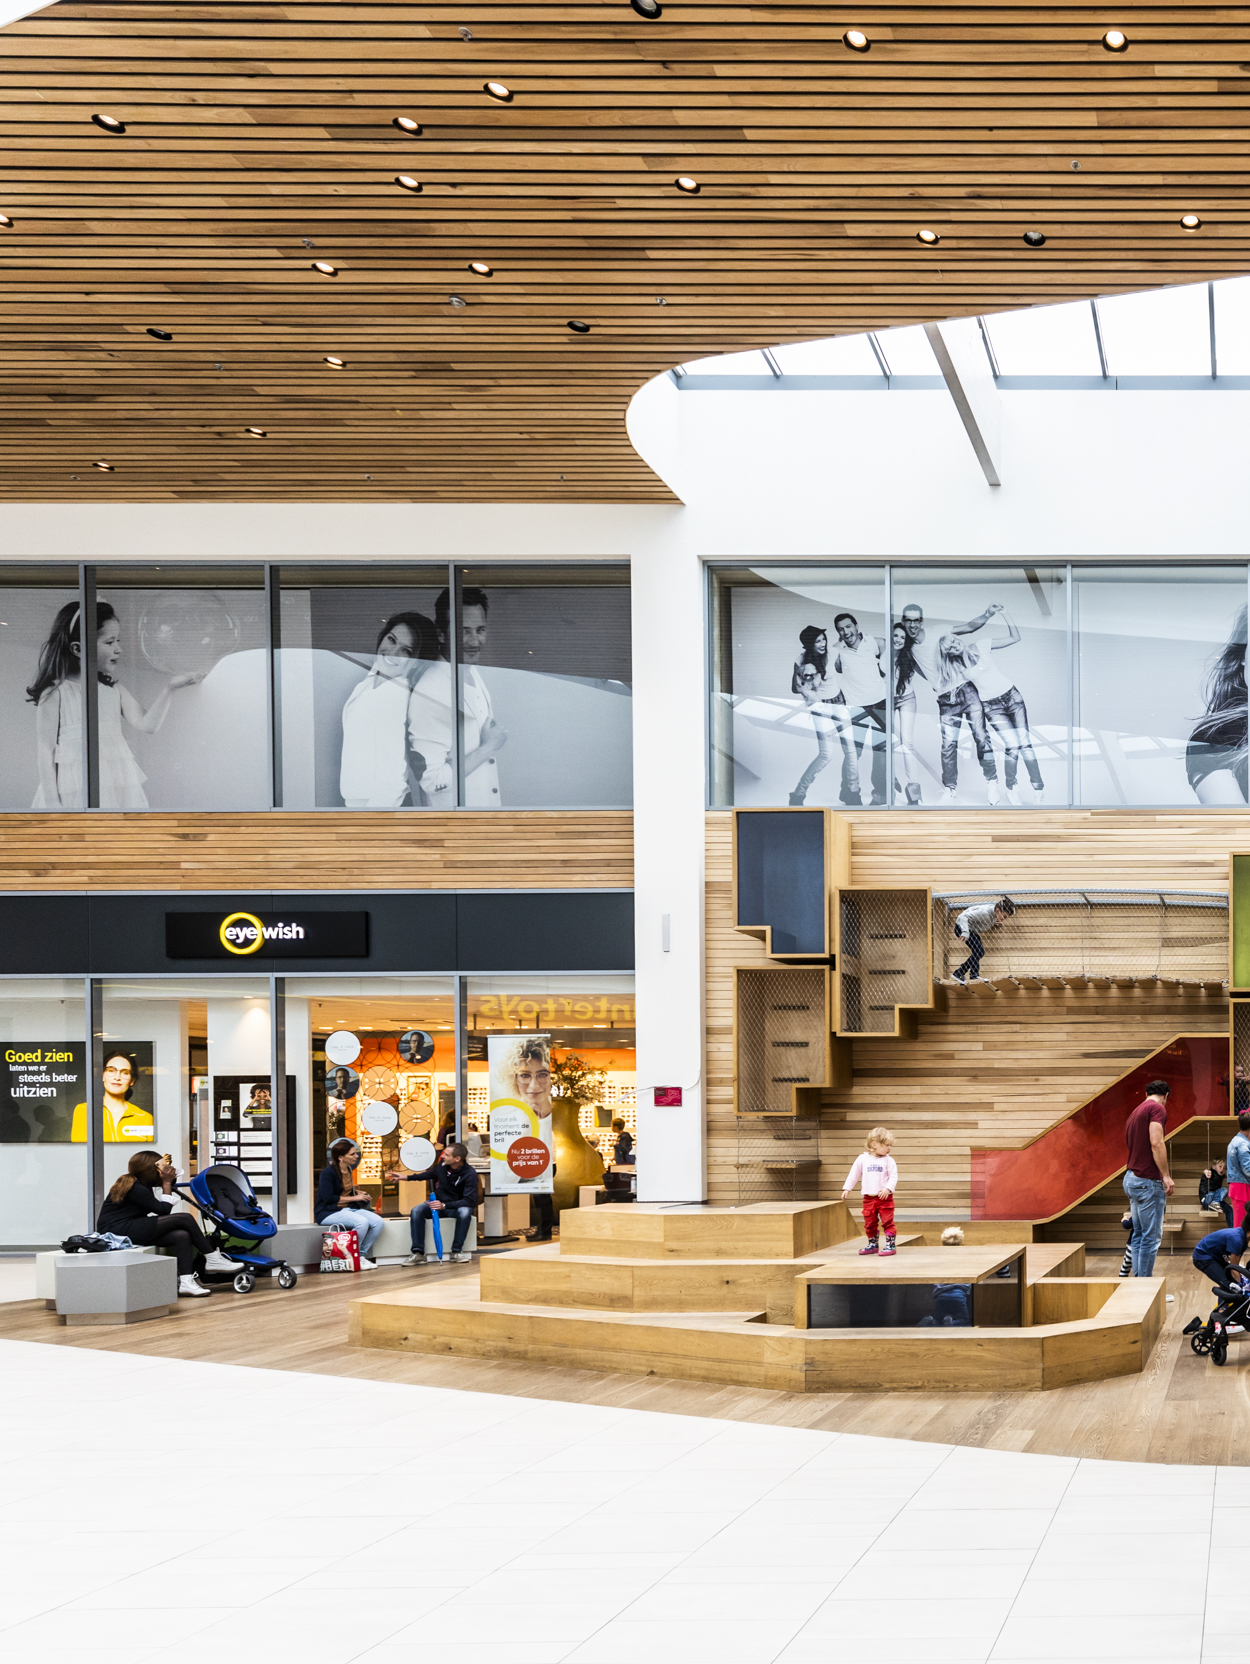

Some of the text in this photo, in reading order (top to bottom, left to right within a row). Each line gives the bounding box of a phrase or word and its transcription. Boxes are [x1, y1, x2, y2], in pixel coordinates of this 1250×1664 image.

[224, 921, 305, 944] eyewish
[5, 1049, 73, 1063] Goed zien
[18, 1073, 77, 1082] steeds beter
[11, 1084, 57, 1097] uitzien
